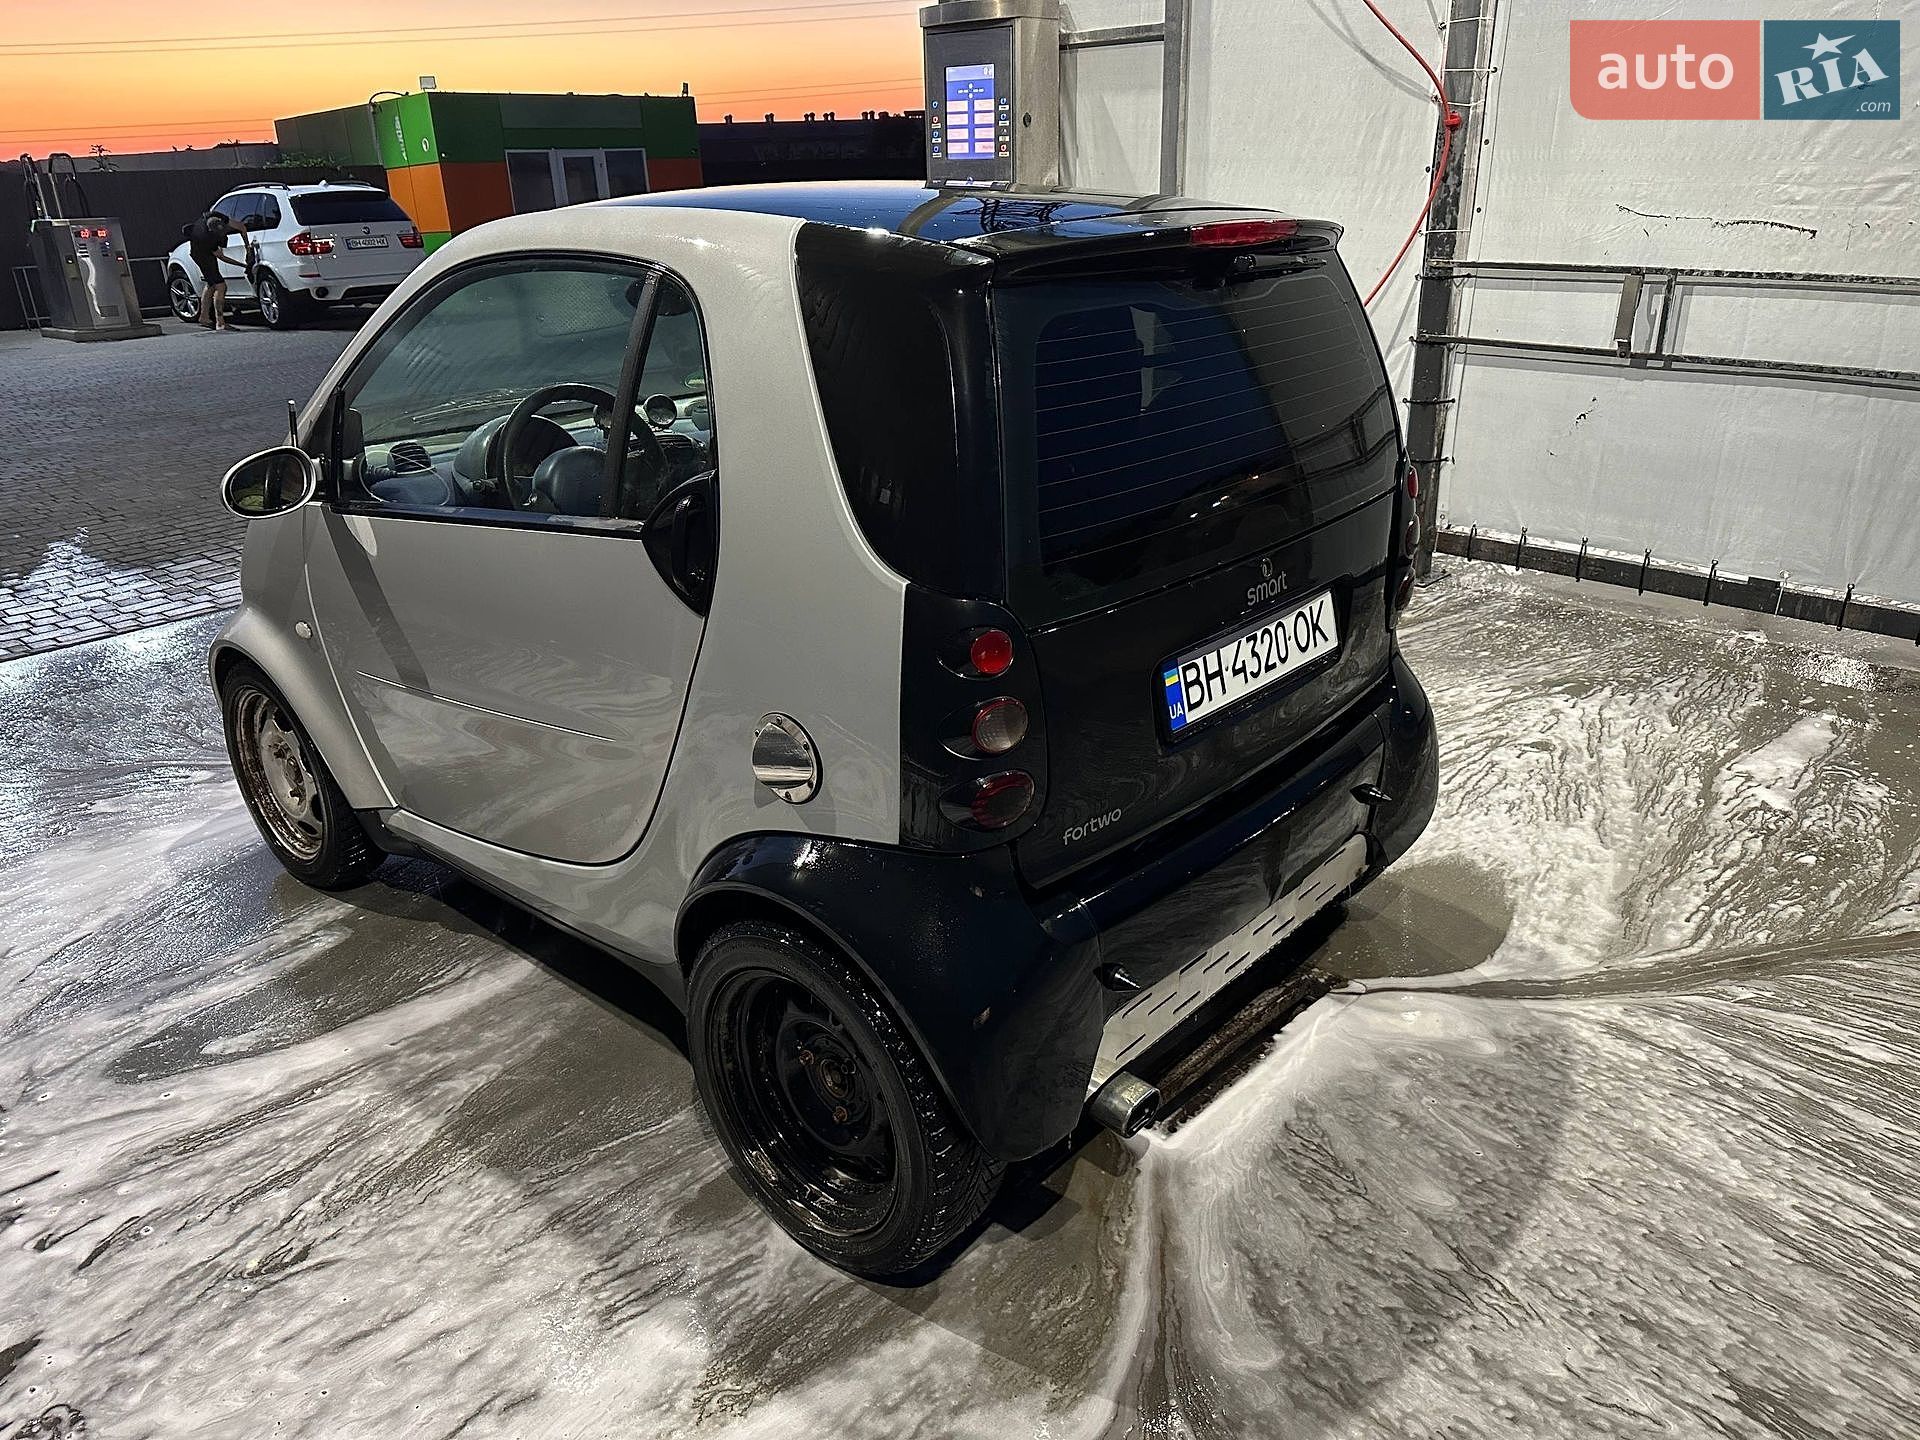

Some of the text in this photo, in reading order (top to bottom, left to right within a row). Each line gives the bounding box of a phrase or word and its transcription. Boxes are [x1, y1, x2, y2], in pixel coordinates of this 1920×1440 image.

[1247, 571, 1288, 606] smart
[1181, 600, 1329, 713] BH 4320 OK
[1169, 703, 1184, 719] UA
